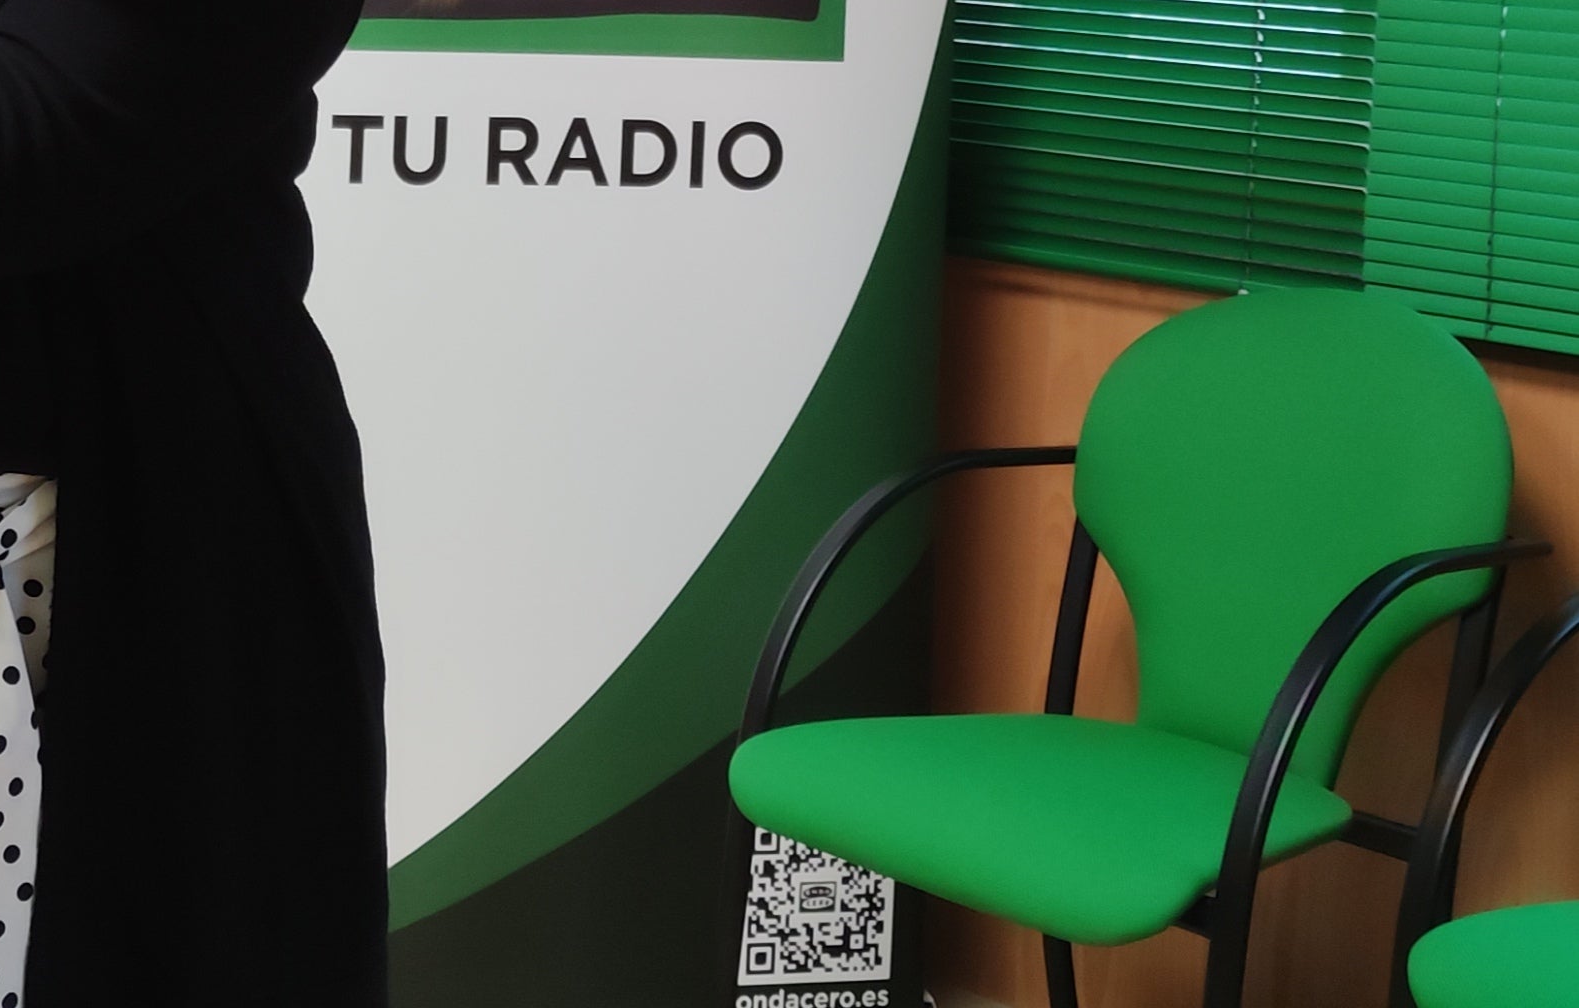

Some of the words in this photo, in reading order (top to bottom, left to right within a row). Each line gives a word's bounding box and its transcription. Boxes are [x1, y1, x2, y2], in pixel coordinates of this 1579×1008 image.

[332, 114, 448, 186] TU
[485, 116, 784, 191] RADIO
[735, 988, 889, 1008] ondacero.es
